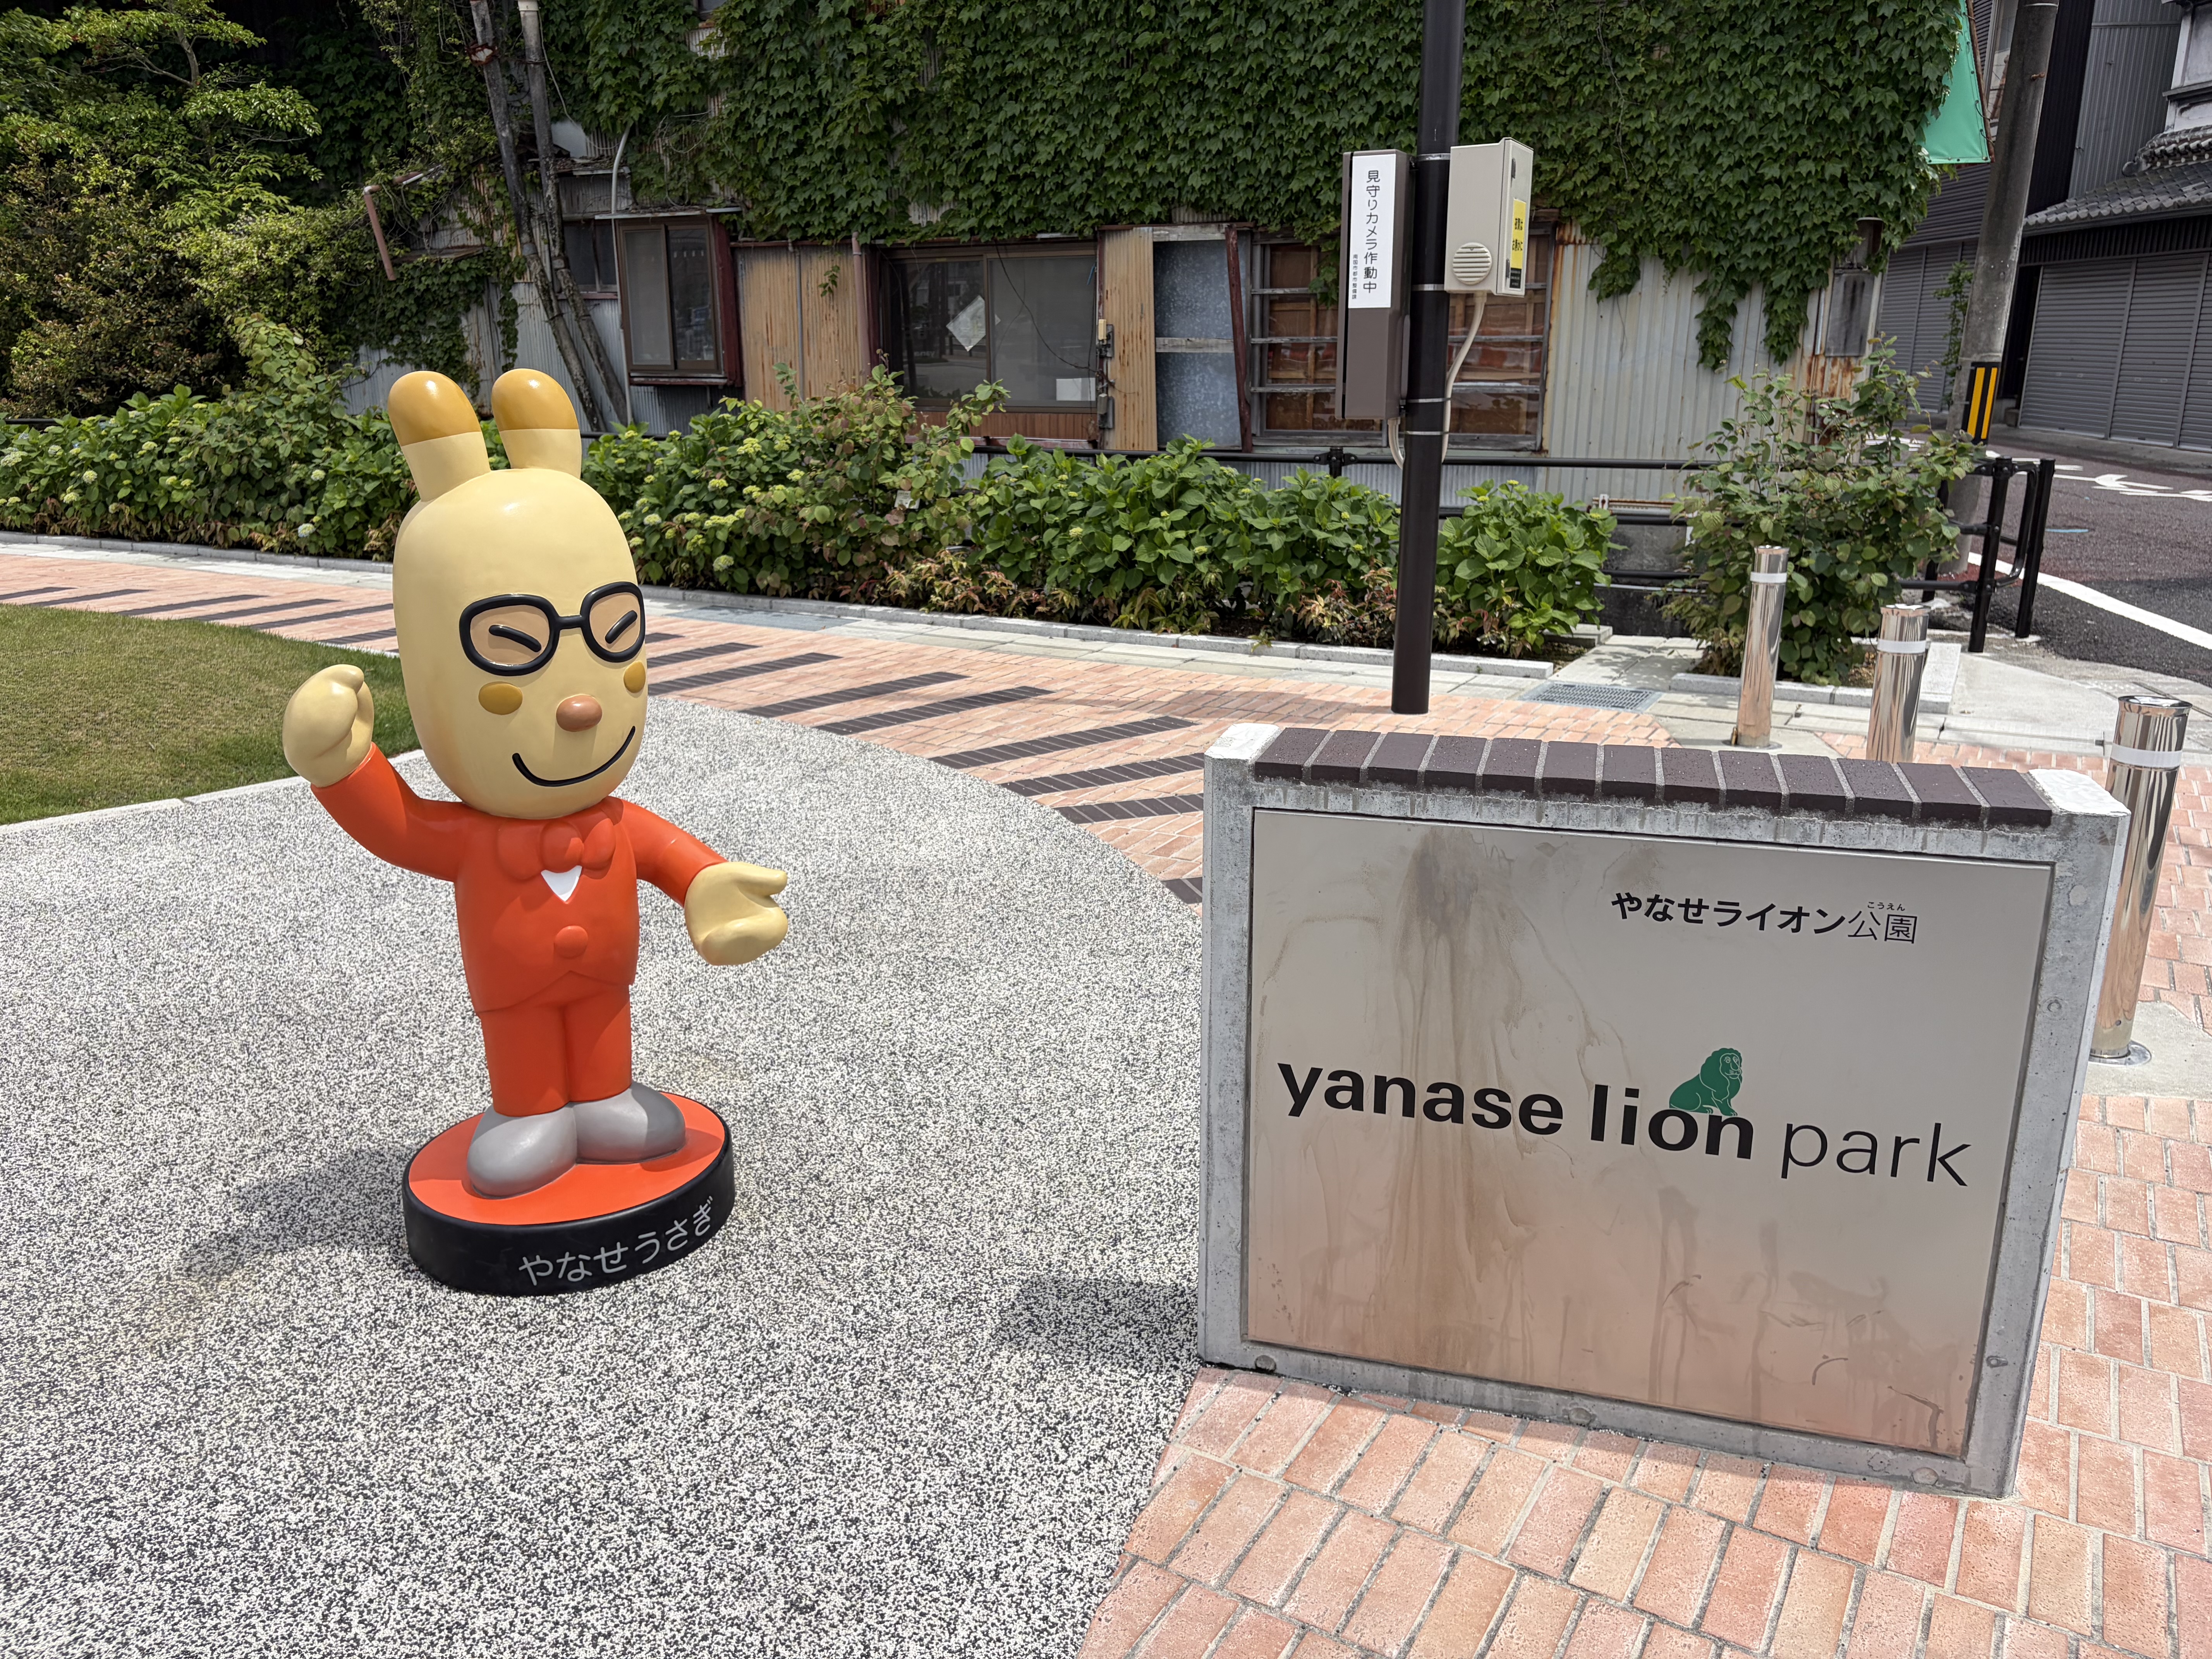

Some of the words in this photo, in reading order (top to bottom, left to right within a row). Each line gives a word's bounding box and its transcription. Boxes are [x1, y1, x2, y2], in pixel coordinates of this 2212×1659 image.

[1363, 170, 1380, 293] 見守りカメラ作動中
[1611, 892, 1918, 944] やなせライオン公園
[1867, 902, 1905, 912] こうえん
[1277, 1062, 1563, 1135] yanase
[1591, 1084, 1754, 1160] lion
[1781, 1123, 1972, 1187] park
[519, 1195, 713, 1286] やなせうさぎ
